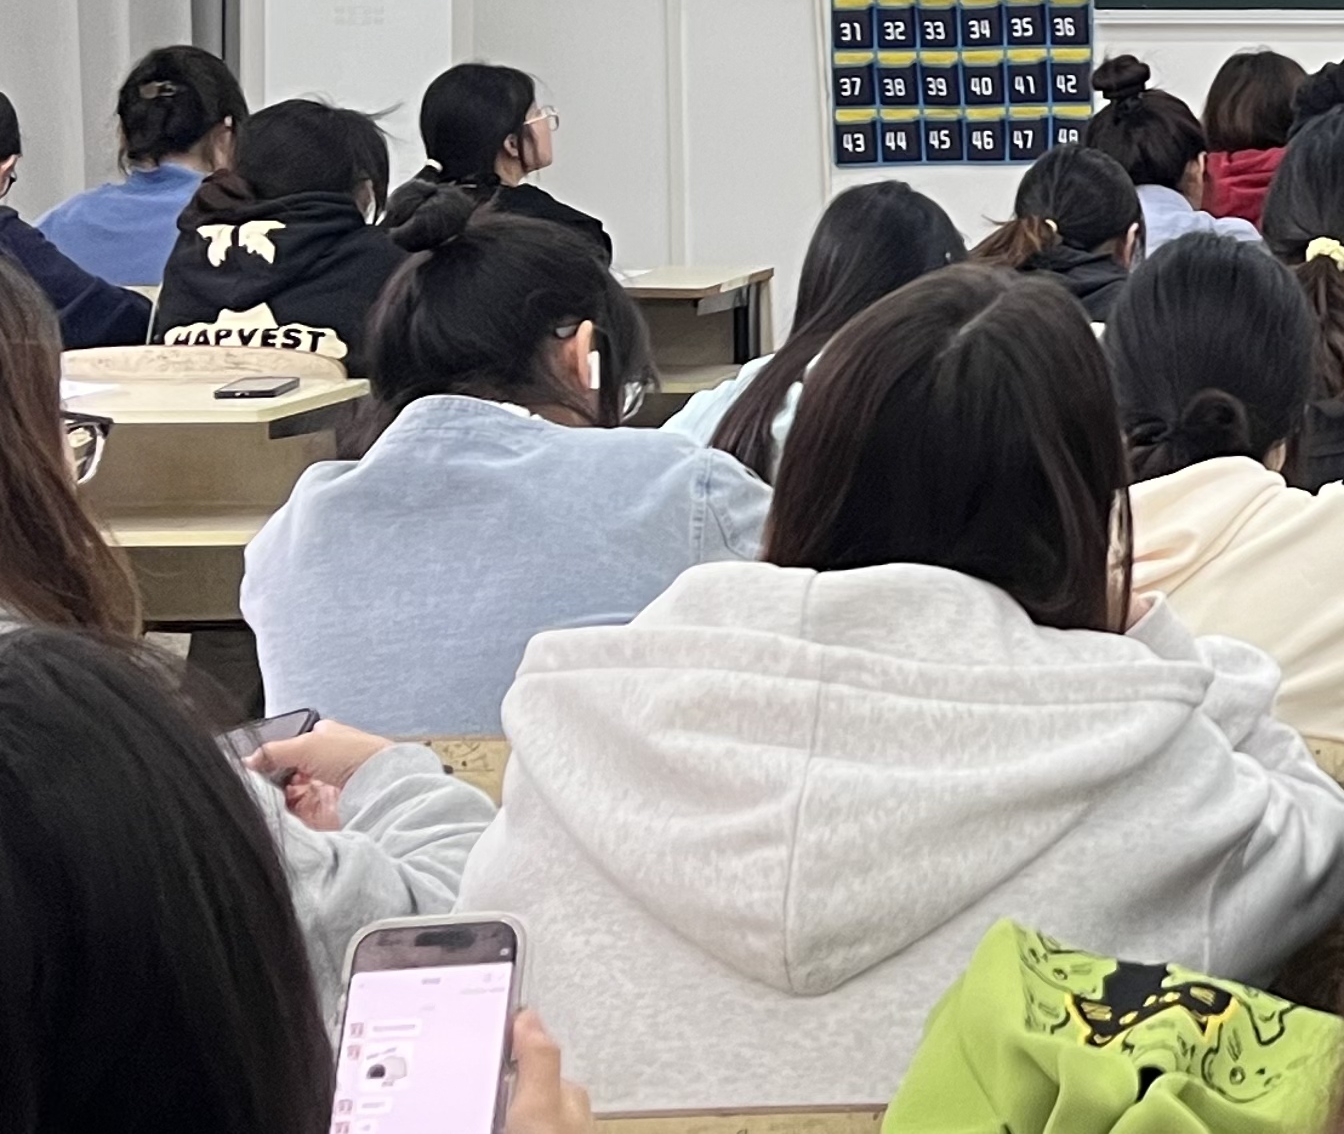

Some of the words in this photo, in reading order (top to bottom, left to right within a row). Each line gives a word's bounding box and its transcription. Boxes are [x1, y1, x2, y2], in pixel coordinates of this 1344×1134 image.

[840, 23, 861, 40] 31
[884, 22, 905, 40] 32
[924, 22, 945, 39] 33
[969, 20, 990, 38] 34
[1011, 18, 1032, 36] 35
[1054, 18, 1075, 36] 36
[840, 78, 860, 96] 37
[884, 79, 905, 96] 38
[927, 78, 946, 95] 39
[971, 78, 992, 95] 40
[1015, 76, 1035, 93] 41
[1057, 75, 1077, 93] 42
[843, 134, 864, 152] 43
[886, 132, 906, 150] 44
[930, 130, 950, 148] 45
[973, 131, 993, 149] 46
[1014, 131, 1032, 148] 47
